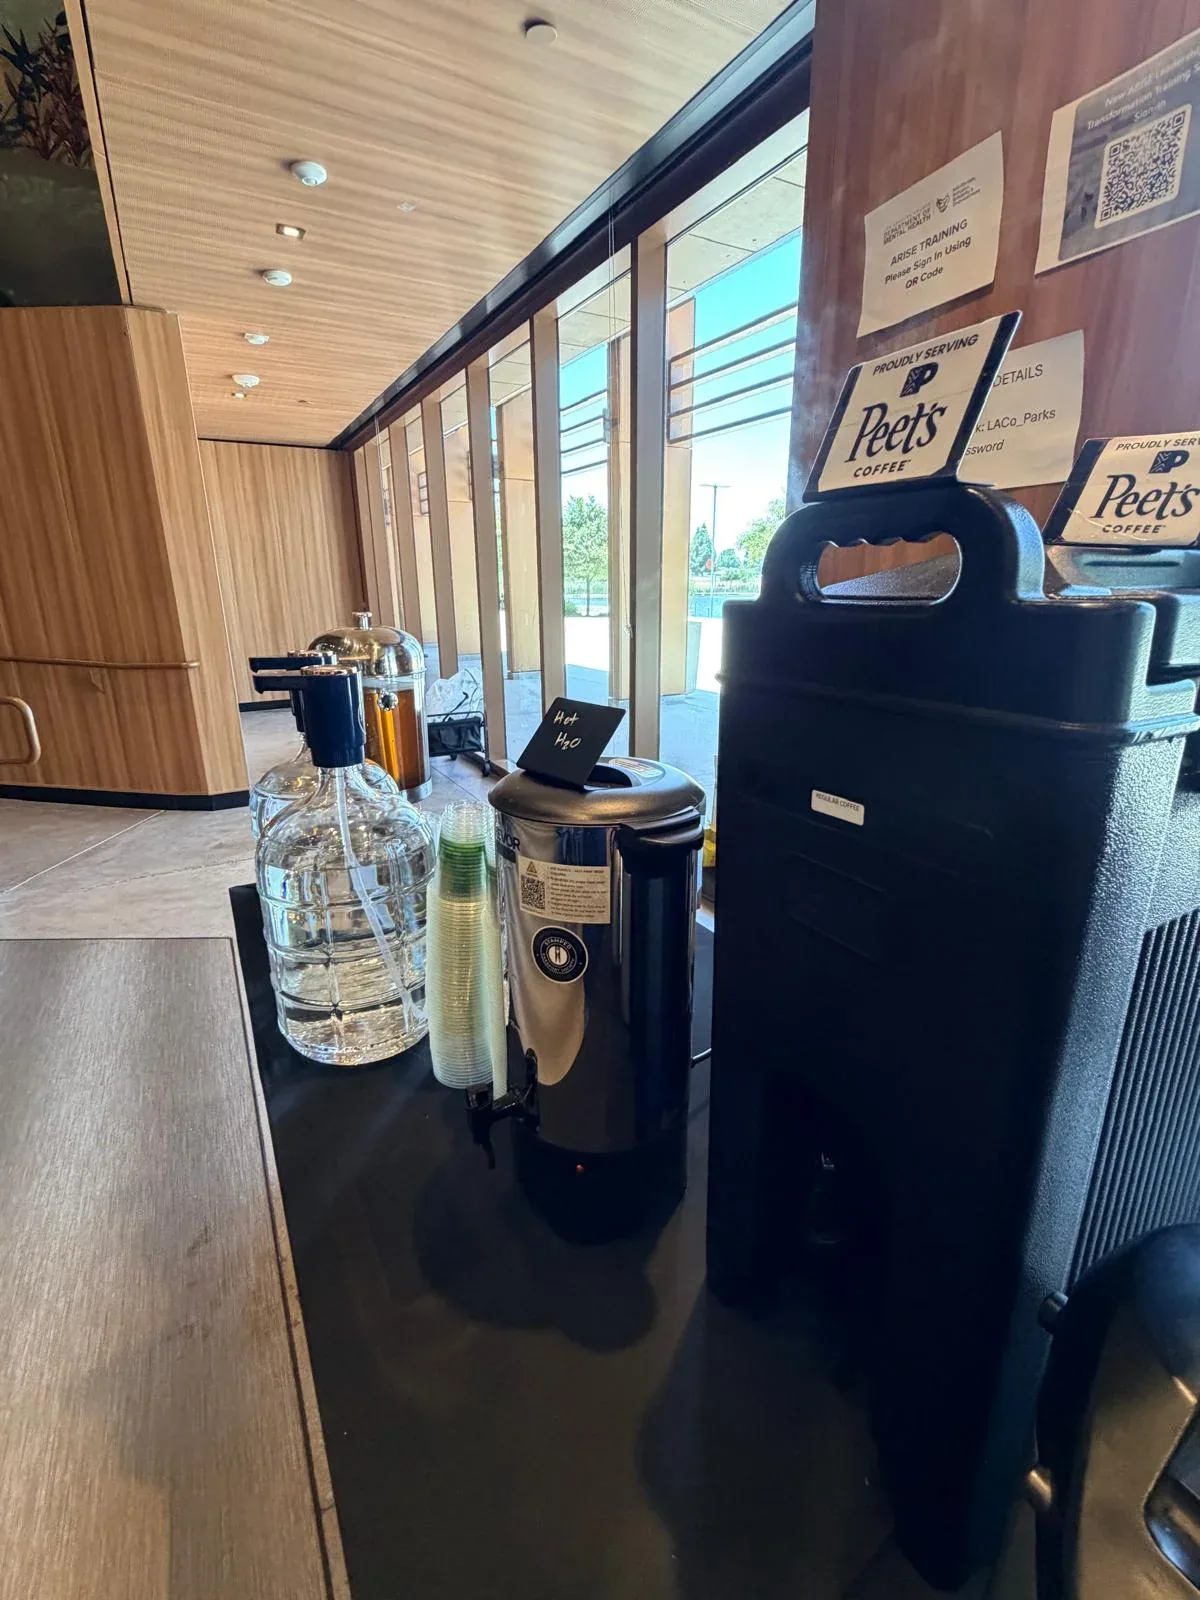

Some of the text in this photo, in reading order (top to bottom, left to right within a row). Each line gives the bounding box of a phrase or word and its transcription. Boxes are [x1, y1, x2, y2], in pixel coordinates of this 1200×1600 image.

[883, 212, 921, 237] DEPARTMENT
[883, 228, 906, 245] MENTAL
[907, 214, 931, 231] HEALTH
[890, 218, 968, 267] ARISE TRAINING
[885, 236, 972, 285] Please Sign In Using
[905, 266, 944, 289] QR Code
[872, 334, 979, 376] PROUDLY SERVING
[993, 364, 1043, 388] DETAILS
[987, 409, 1057, 432] LACo_Parks
[844, 402, 948, 464] Peet's
[1115, 439, 1171, 451] PROUDLY
[853, 460, 907, 478] COFFEE
[1090, 473, 1200, 520] Peet's
[1102, 524, 1162, 534] COFFEE
[553, 710, 580, 726] Hot
[839, 800, 860, 811] COFFEE
